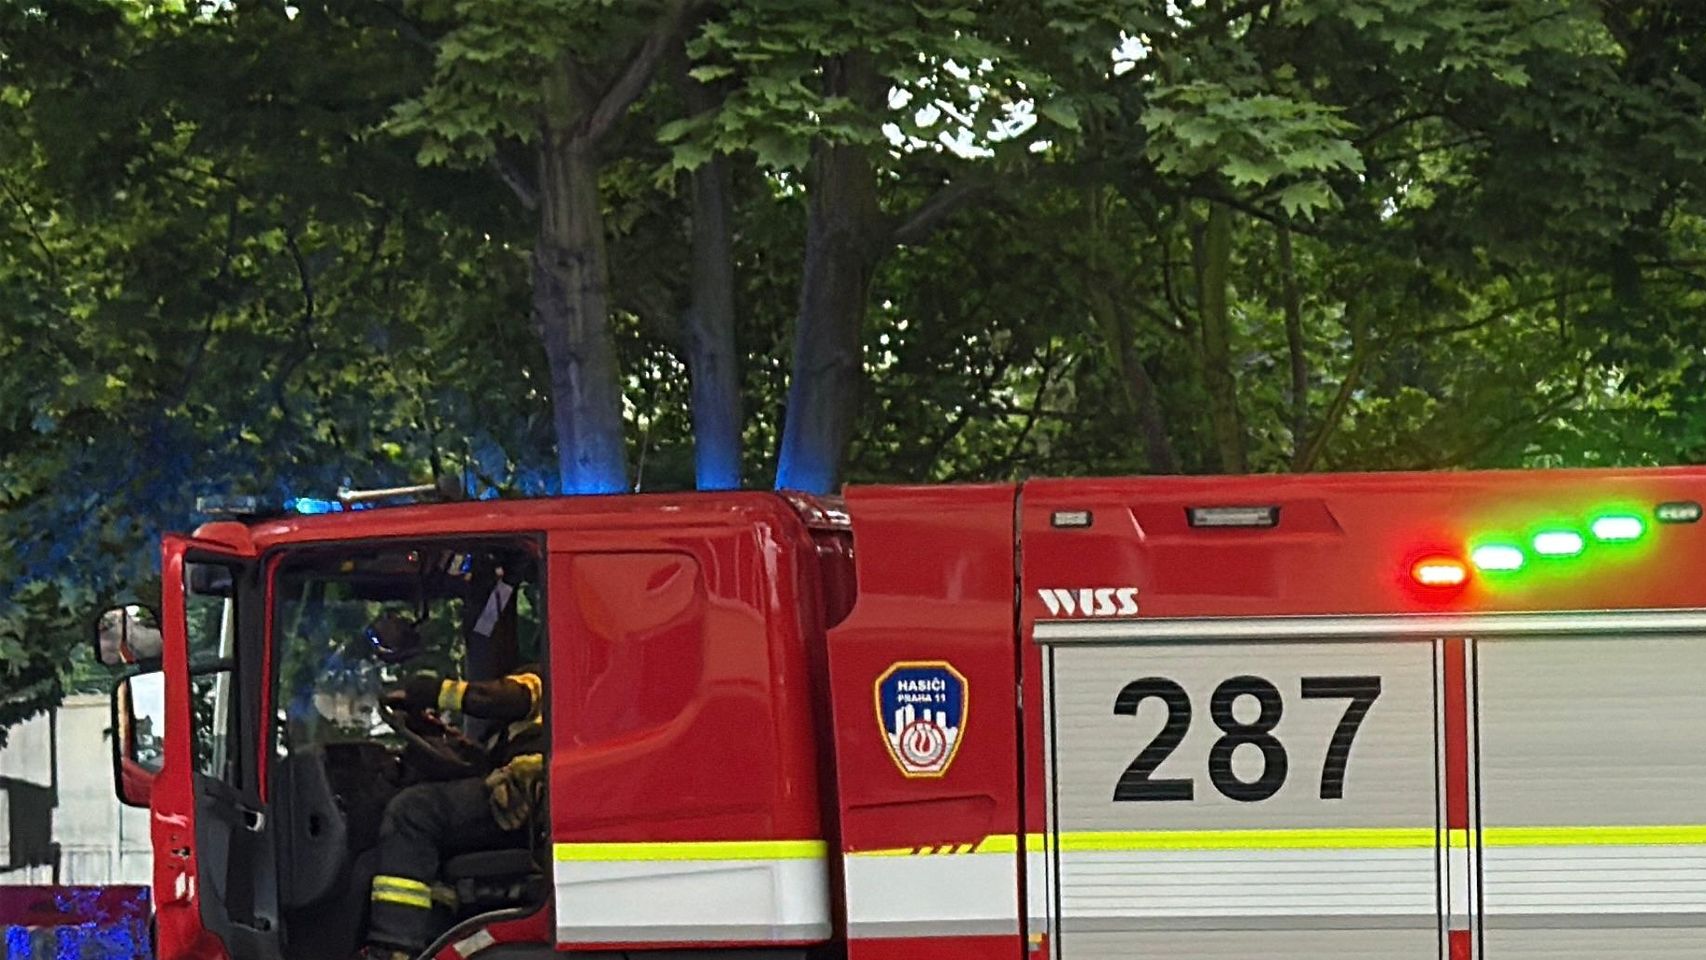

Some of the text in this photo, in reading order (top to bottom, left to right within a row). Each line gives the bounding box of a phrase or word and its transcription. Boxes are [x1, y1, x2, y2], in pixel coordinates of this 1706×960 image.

[1038, 587, 1139, 616] WISS
[897, 676, 946, 692] HASIČI
[897, 693, 946, 702] PRAHA 11
[1112, 675, 1382, 802] 287
